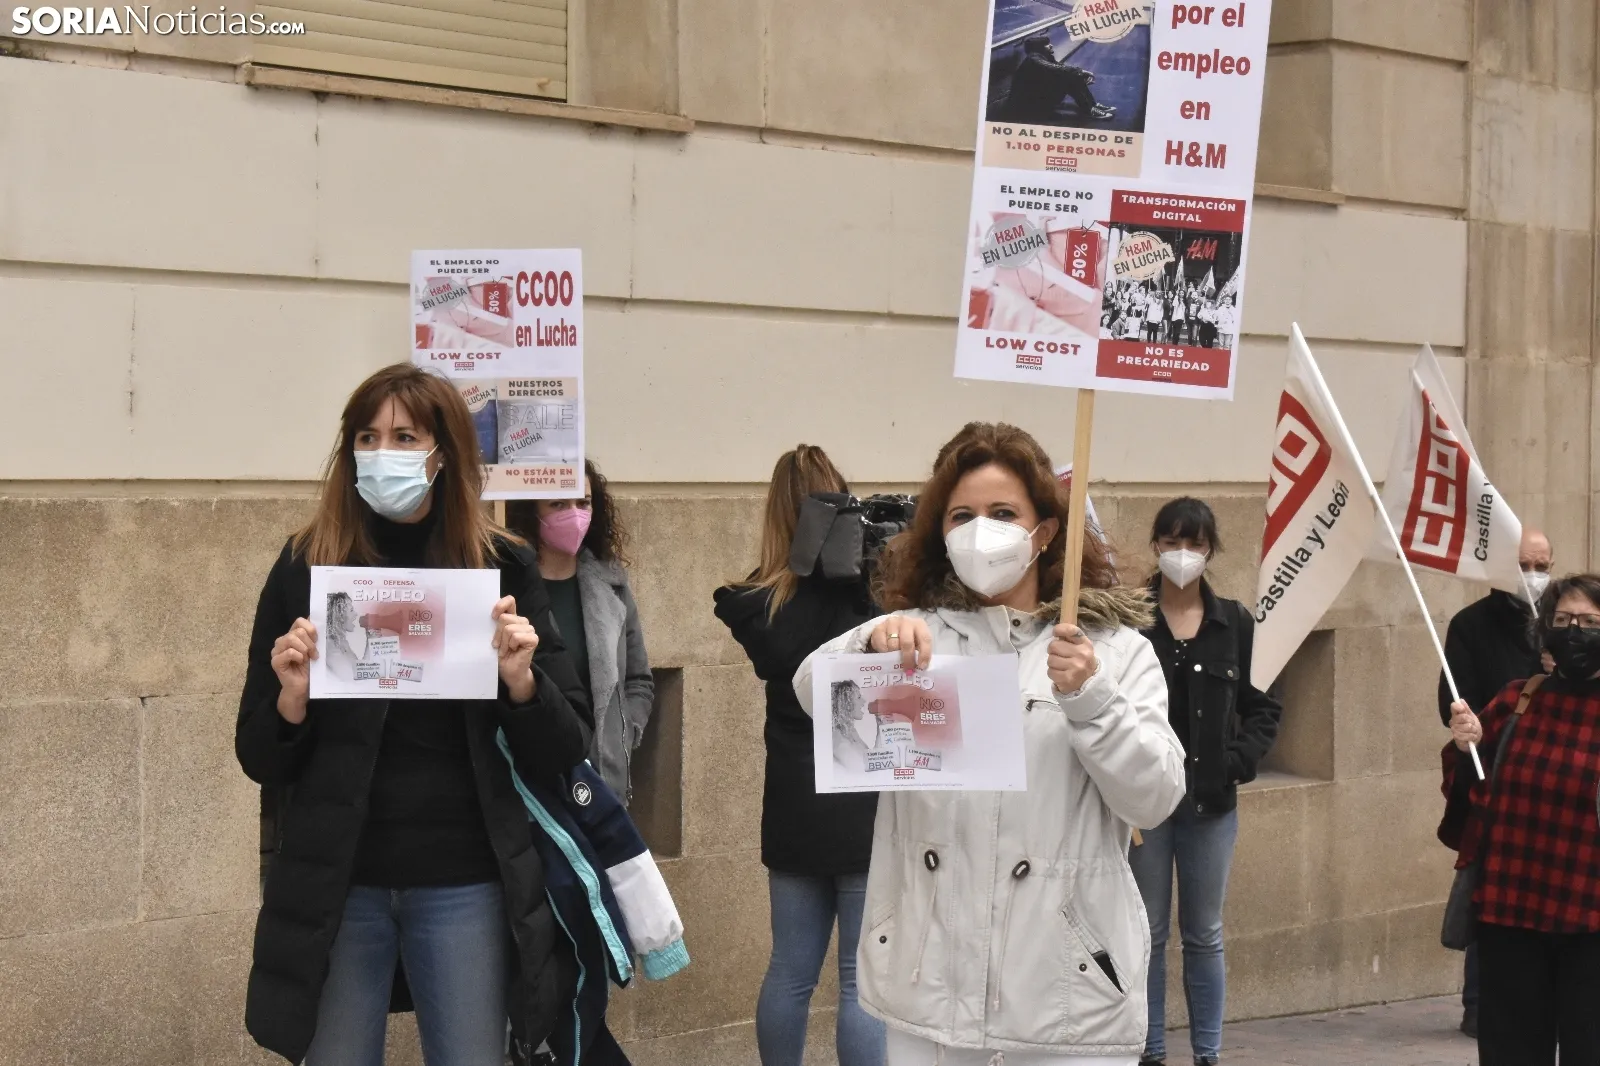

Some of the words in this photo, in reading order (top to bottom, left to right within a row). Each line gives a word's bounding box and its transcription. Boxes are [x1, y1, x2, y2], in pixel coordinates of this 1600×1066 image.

[1084, 0, 1119, 17] H&M
[1172, 3, 1215, 29] por
[1221, 3, 1245, 27] el
[1070, 21, 1091, 37] EN
[1093, 7, 1142, 32] LUCHA
[1157, 49, 1250, 79] empleo
[1180, 100, 1210, 120] en
[992, 126, 1013, 136] NO
[1018, 128, 1037, 138] AL
[1043, 130, 1108, 143] DESPIDO
[1114, 135, 1134, 145] DE
[1005, 141, 1041, 152] 1.100
[1047, 144, 1126, 158] PERSONAS
[1165, 140, 1227, 169] H&M
[1046, 156, 1077, 168] CCOO
[1000, 185, 1015, 194] EL
[1019, 186, 1071, 198] EMPLEO
[1075, 190, 1094, 201] NO
[1008, 200, 1051, 212] PUEDE
[1055, 203, 1079, 214] SER
[1121, 194, 1236, 212] TRANSFORMACIÓN
[1153, 211, 1202, 223] DIGITAL
[994, 225, 1026, 245] H&M
[982, 248, 1001, 265] EN
[1001, 233, 1045, 257] LUCHA
[1125, 240, 1153, 258] H&M
[1186, 238, 1218, 261] H&M
[1071, 242, 1089, 279] 50%
[1114, 261, 1131, 276] EN
[1133, 248, 1171, 271] LUCHA
[429, 283, 452, 297] H&M
[516, 270, 574, 307] CCOO
[422, 300, 435, 310] EN
[438, 287, 468, 305] LUCHA
[489, 290, 500, 313] 50%
[516, 325, 532, 347] en
[536, 318, 577, 347] Lucha
[985, 336, 1029, 351] LOW
[1034, 340, 1082, 356] COST
[1145, 346, 1163, 356] NO
[1168, 348, 1184, 357] ES
[430, 352, 461, 361] LOW
[467, 352, 502, 360] COST
[1016, 354, 1043, 366] CCOO
[1117, 355, 1210, 372] PRECARIEDAD
[462, 385, 480, 398] H&M
[508, 380, 563, 388] NUESTROS
[466, 389, 491, 406] LUCHA
[508, 389, 564, 397] DERECHOS
[510, 428, 530, 441] H&M
[503, 443, 515, 455] EN
[516, 432, 543, 450] LUCHA
[524, 467, 556, 476] ESTÁN
[1315, 480, 1350, 530] León
[1473, 493, 1494, 562] Castilla
[1306, 527, 1325, 550] y
[1254, 546, 1312, 624] Castilla
[353, 589, 426, 603] EMPLEO
[408, 610, 432, 621] NO
[408, 624, 432, 632] ERES
[357, 671, 380, 679] BBVA
[379, 678, 398, 686] CCOO
[861, 673, 935, 690] EMPLEO
[920, 697, 945, 710] NO
[868, 760, 894, 770] BBVA
